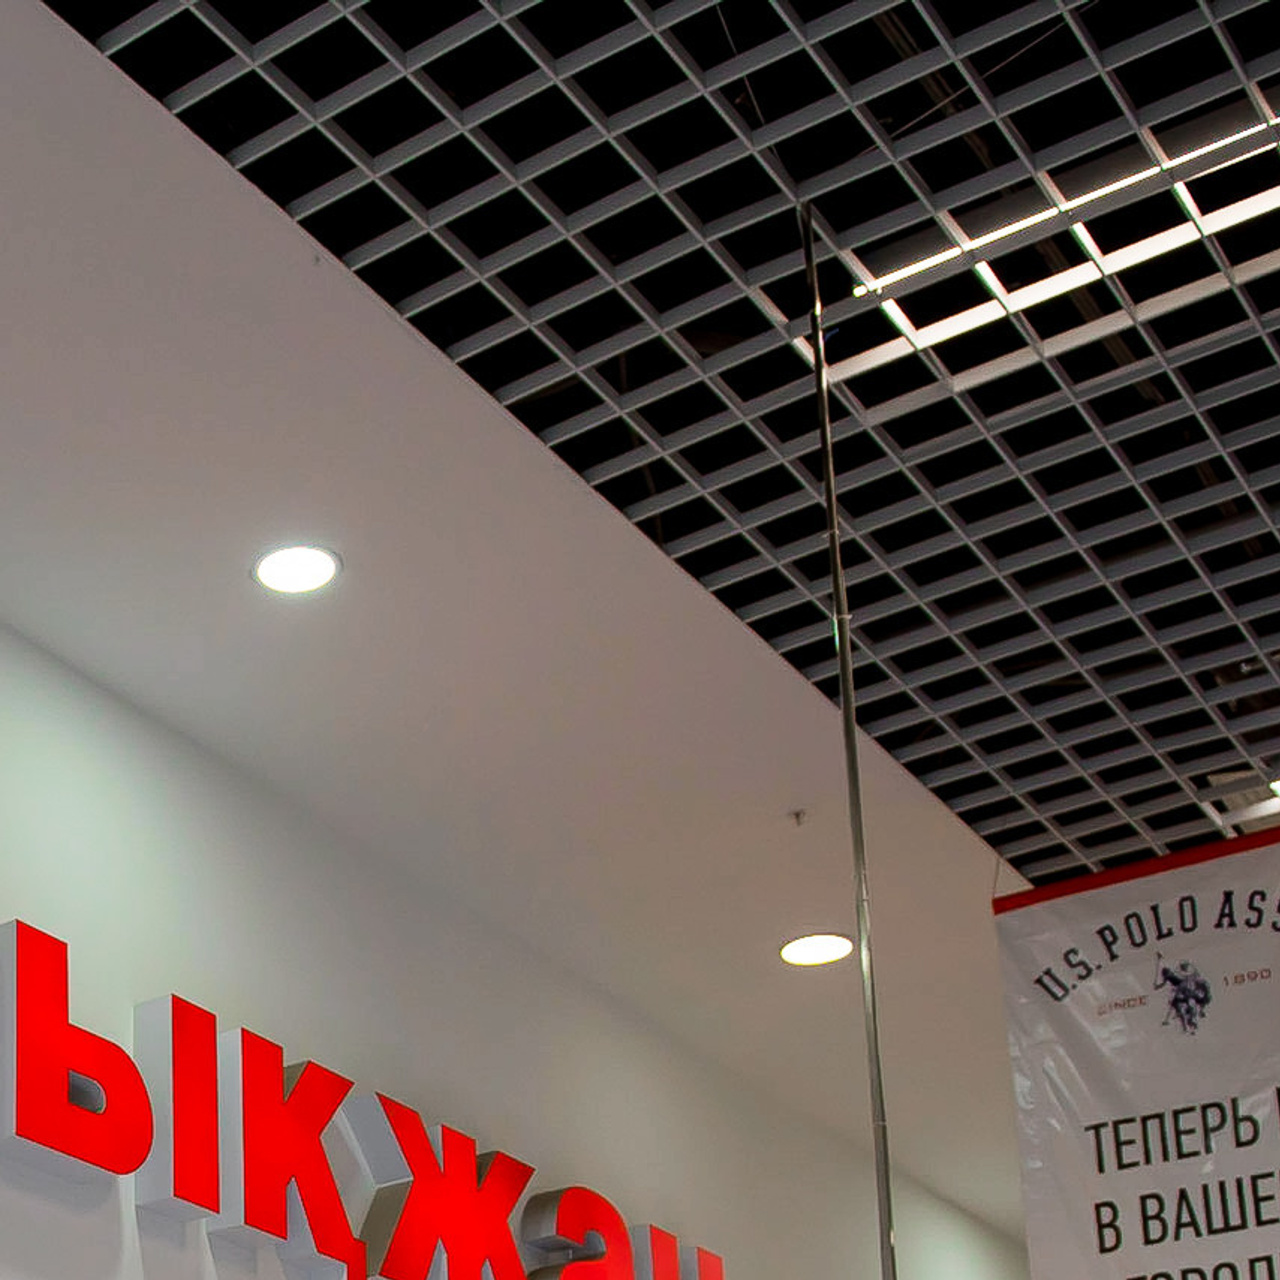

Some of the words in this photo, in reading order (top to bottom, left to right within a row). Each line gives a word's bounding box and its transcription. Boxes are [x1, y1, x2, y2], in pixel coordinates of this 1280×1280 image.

[1034, 947, 1102, 1002] U.S.
[1095, 895, 1198, 961] POLO
[1223, 968, 1272, 987] 1890
[1084, 1097, 1261, 1174] ТЕПЕРЬ
[1094, 1201, 1122, 1254] В
